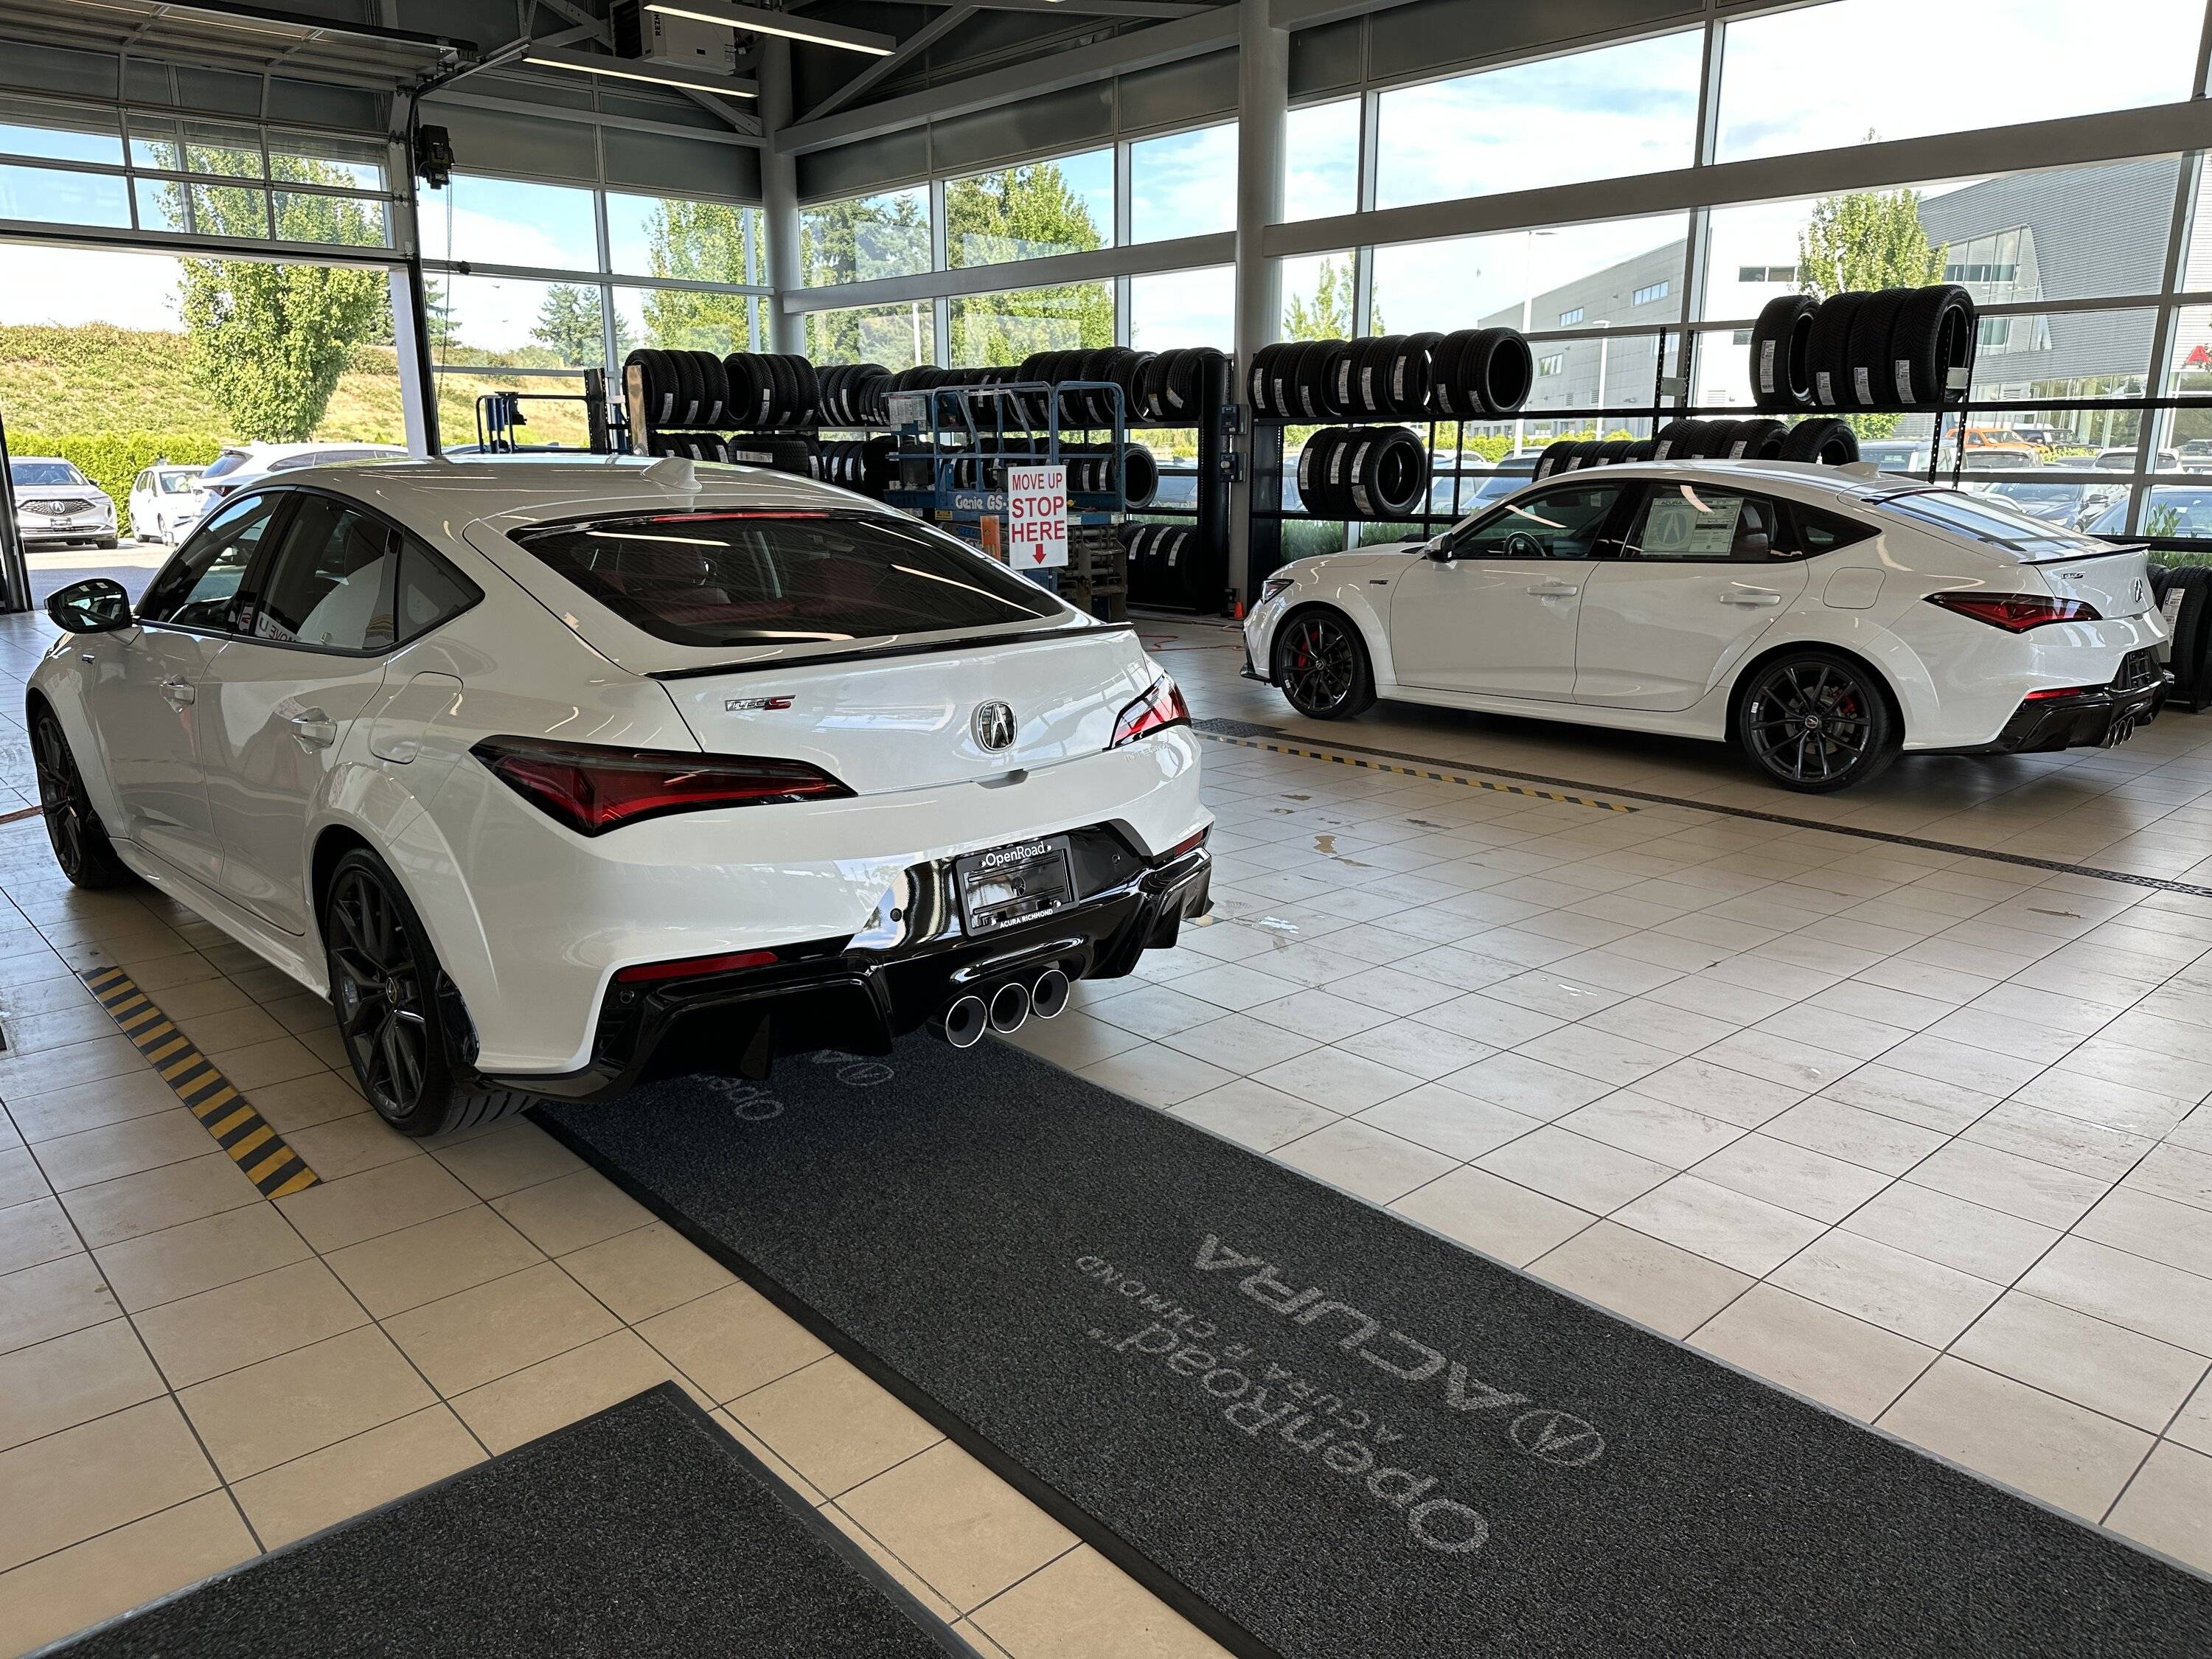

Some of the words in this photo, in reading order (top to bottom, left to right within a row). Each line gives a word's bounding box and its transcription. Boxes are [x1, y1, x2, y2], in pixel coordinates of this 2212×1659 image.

[1012, 473, 1044, 490] MOVE
[1048, 473, 1062, 489] UP
[956, 494, 984, 509] Genie
[987, 494, 1009, 510] GS-
[1012, 495, 1065, 518] STOP
[1012, 520, 1065, 543] HERE
[985, 841, 1046, 867] OpenRoad
[999, 918, 1021, 928] ACURA
[1022, 908, 1054, 922] RICHMOND
[1194, 1234, 1531, 1411] ACURA
